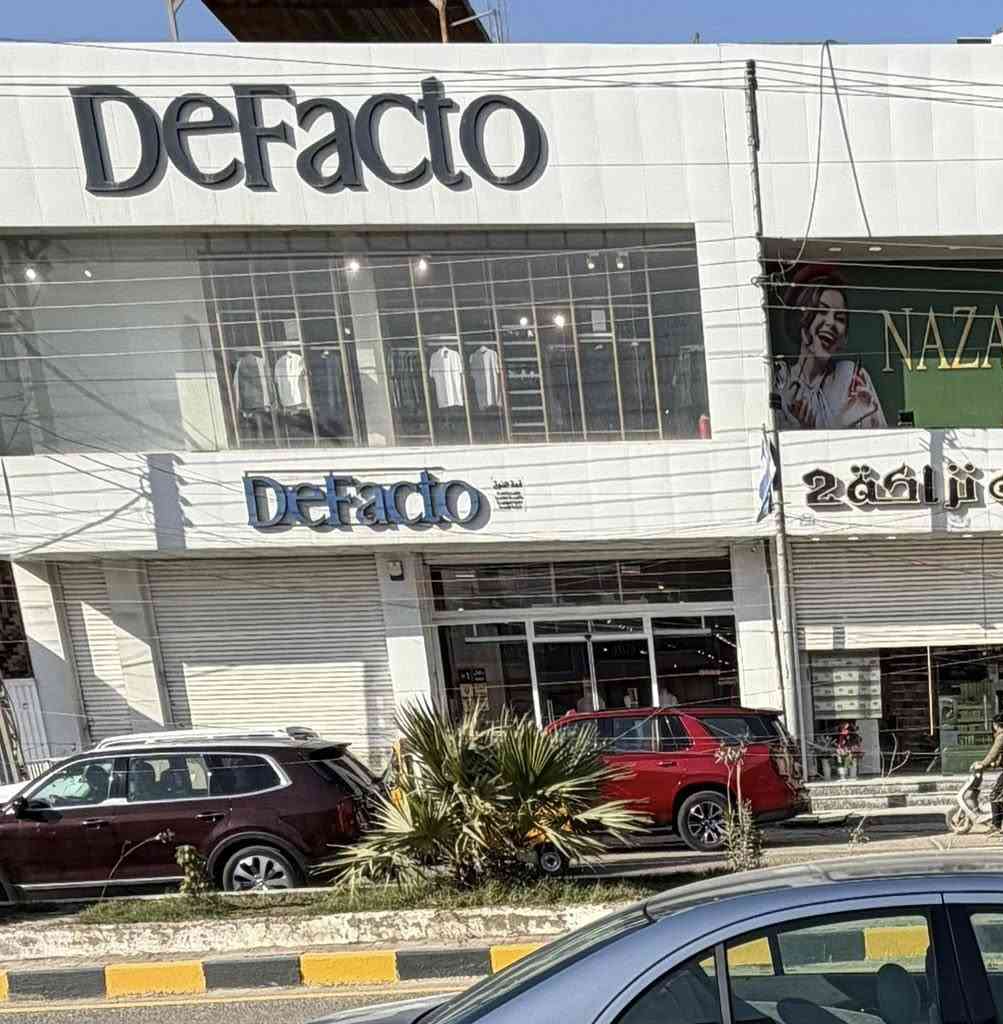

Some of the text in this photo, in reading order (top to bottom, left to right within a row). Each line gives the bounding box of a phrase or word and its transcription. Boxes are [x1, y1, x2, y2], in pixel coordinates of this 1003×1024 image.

[68, 76, 549, 197] DeFacto
[242, 468, 482, 529] DeFacto
[802, 468, 843, 506] 2
